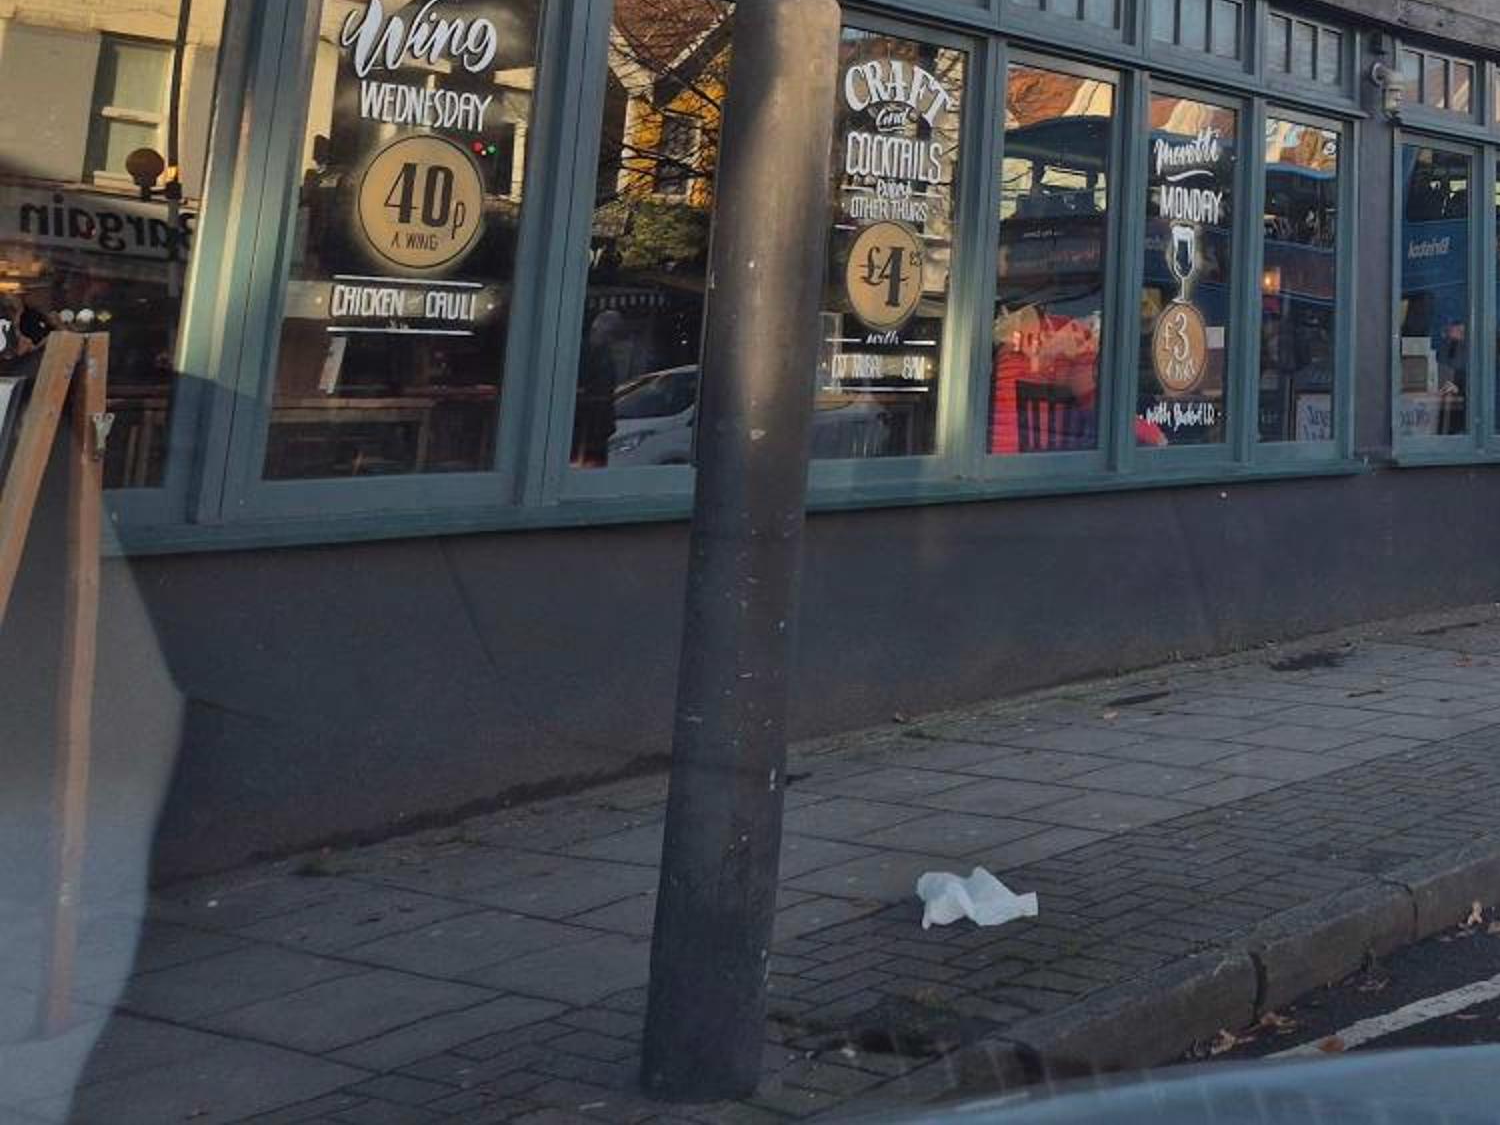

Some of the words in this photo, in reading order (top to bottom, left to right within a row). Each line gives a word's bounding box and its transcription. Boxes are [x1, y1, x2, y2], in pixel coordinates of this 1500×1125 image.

[360, 79, 494, 133] WEDNESDAY
[844, 59, 952, 129] CRAFT
[844, 131, 943, 186] COCKTAILS
[383, 162, 467, 241] 40p
[1159, 185, 1223, 226] MONDAY
[405, 233, 441, 252] WING
[331, 284, 404, 318] CHICKEN
[425, 291, 477, 322] CAULI
